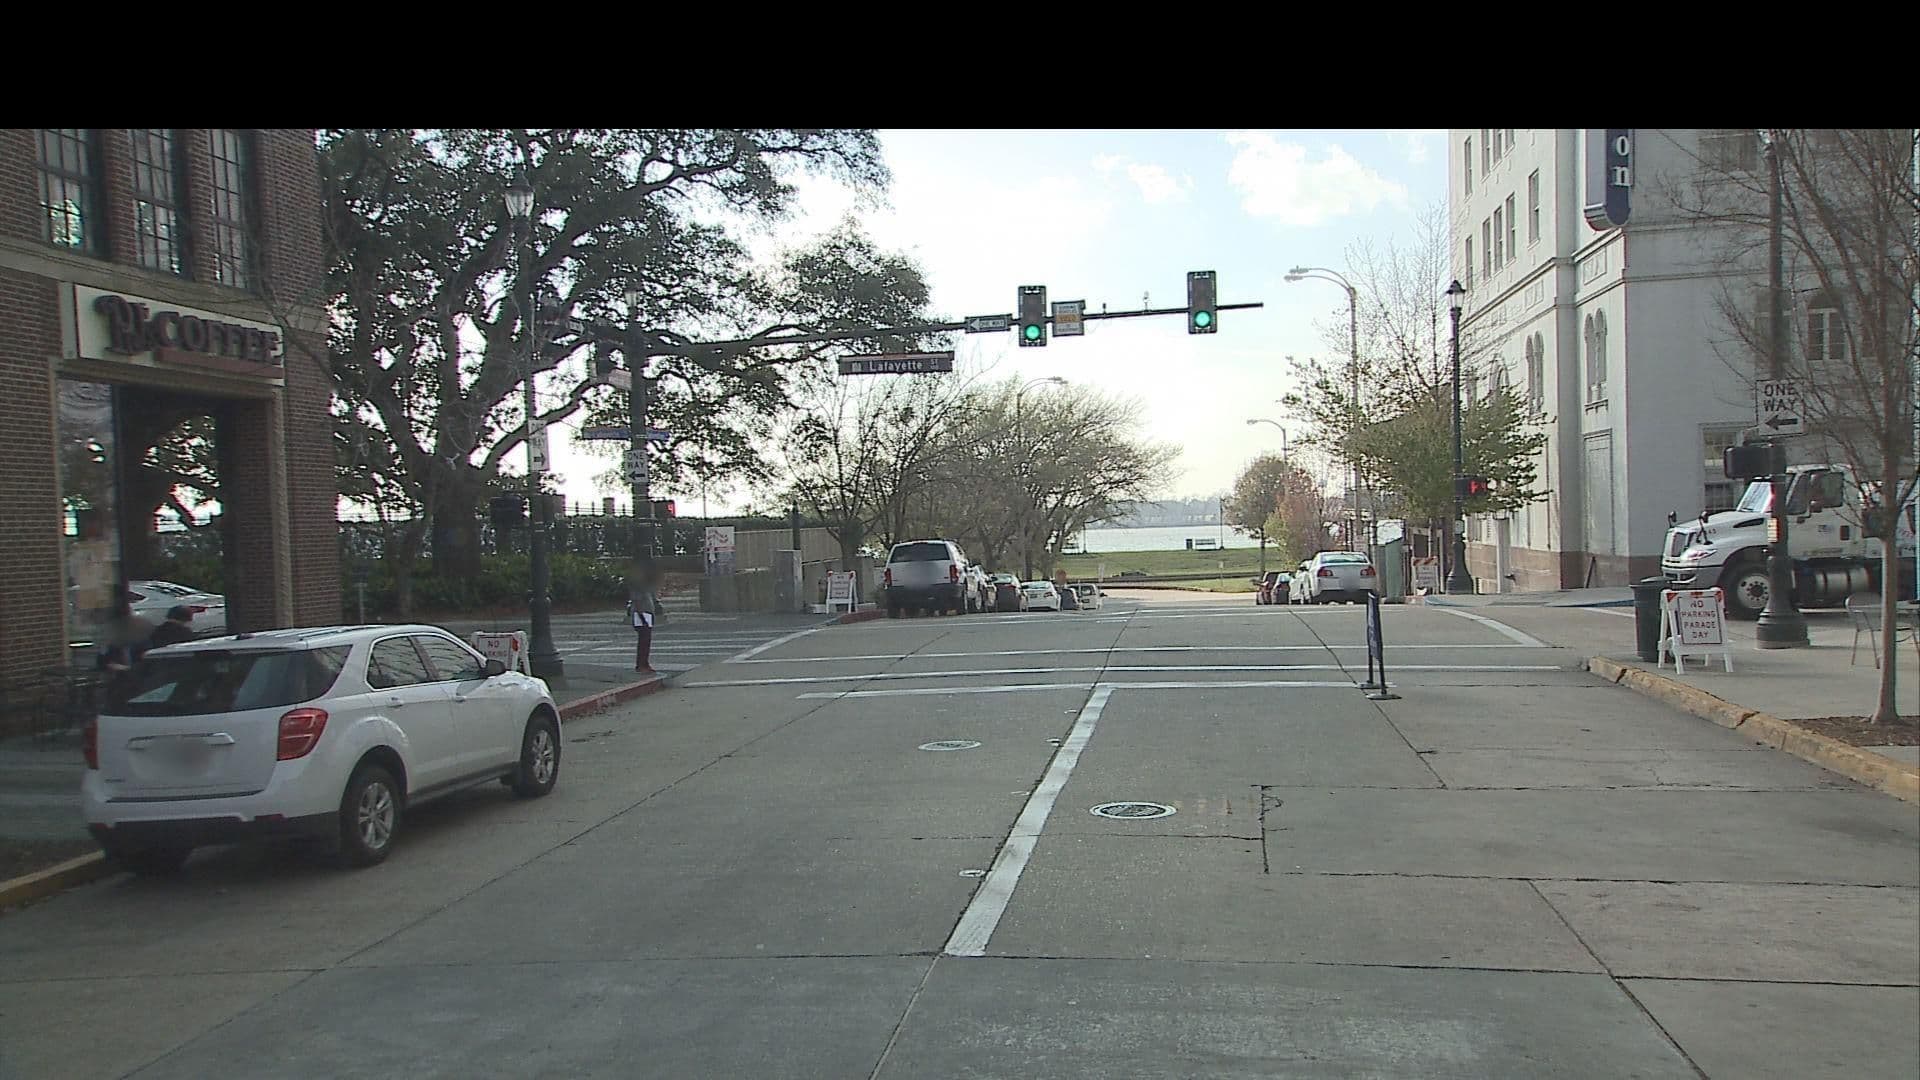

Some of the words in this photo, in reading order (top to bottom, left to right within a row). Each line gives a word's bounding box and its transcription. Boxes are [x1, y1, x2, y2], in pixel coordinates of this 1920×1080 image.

[153, 311, 284, 366] COFFEE
[869, 360, 923, 372] Lafayette
[1764, 383, 1796, 397] ONE
[1764, 398, 1796, 411] WAY
[628, 452, 644, 460] ONE
[1690, 600, 1704, 608] NO
